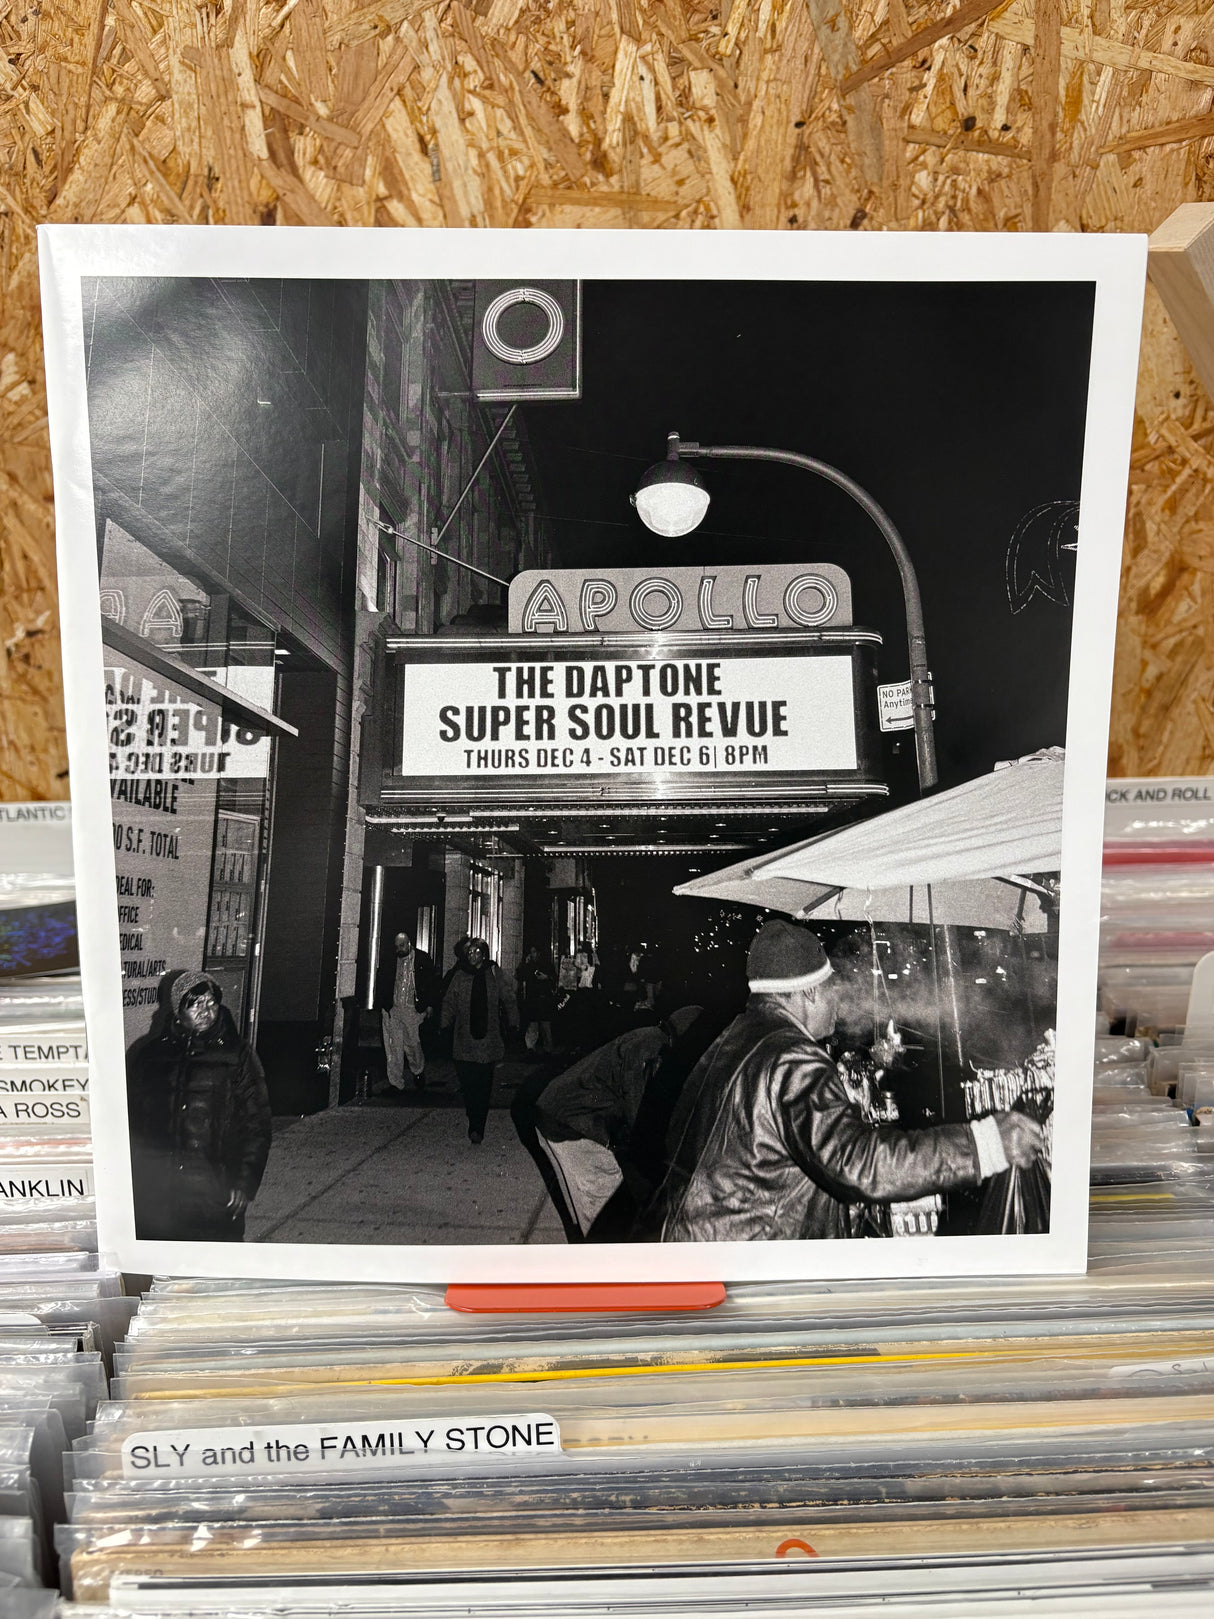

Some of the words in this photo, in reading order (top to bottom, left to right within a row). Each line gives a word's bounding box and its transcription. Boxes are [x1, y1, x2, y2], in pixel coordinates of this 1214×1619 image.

[522, 573, 838, 632] APOLLO
[493, 666, 555, 699] THE
[565, 663, 722, 698] DAPTONE
[882, 690, 894, 698] NO
[439, 703, 556, 742] SUPER
[568, 702, 660, 740] SOUL
[672, 700, 788, 739] REVUE
[464, 748, 530, 769] THURS
[536, 747, 574, 768] DEC
[580, 746, 592, 767] 4
[609, 746, 647, 767] SAT
[653, 745, 691, 766] DEC
[724, 744, 768, 765] 8PM
[1133, 788, 1167, 802] AND
[1171, 787, 1206, 801] ROLL
[125, 826, 146, 854] S.F.
[150, 830, 179, 859] TOTAL
[136, 877, 155, 897] FOR:
[15, 1102, 81, 1118] ROSS
[130, 1443, 190, 1470] SLY
[202, 1441, 256, 1466] and
[264, 1439, 310, 1463] the
[320, 1429, 435, 1460] FAMILY
[445, 1422, 555, 1450] STONE
